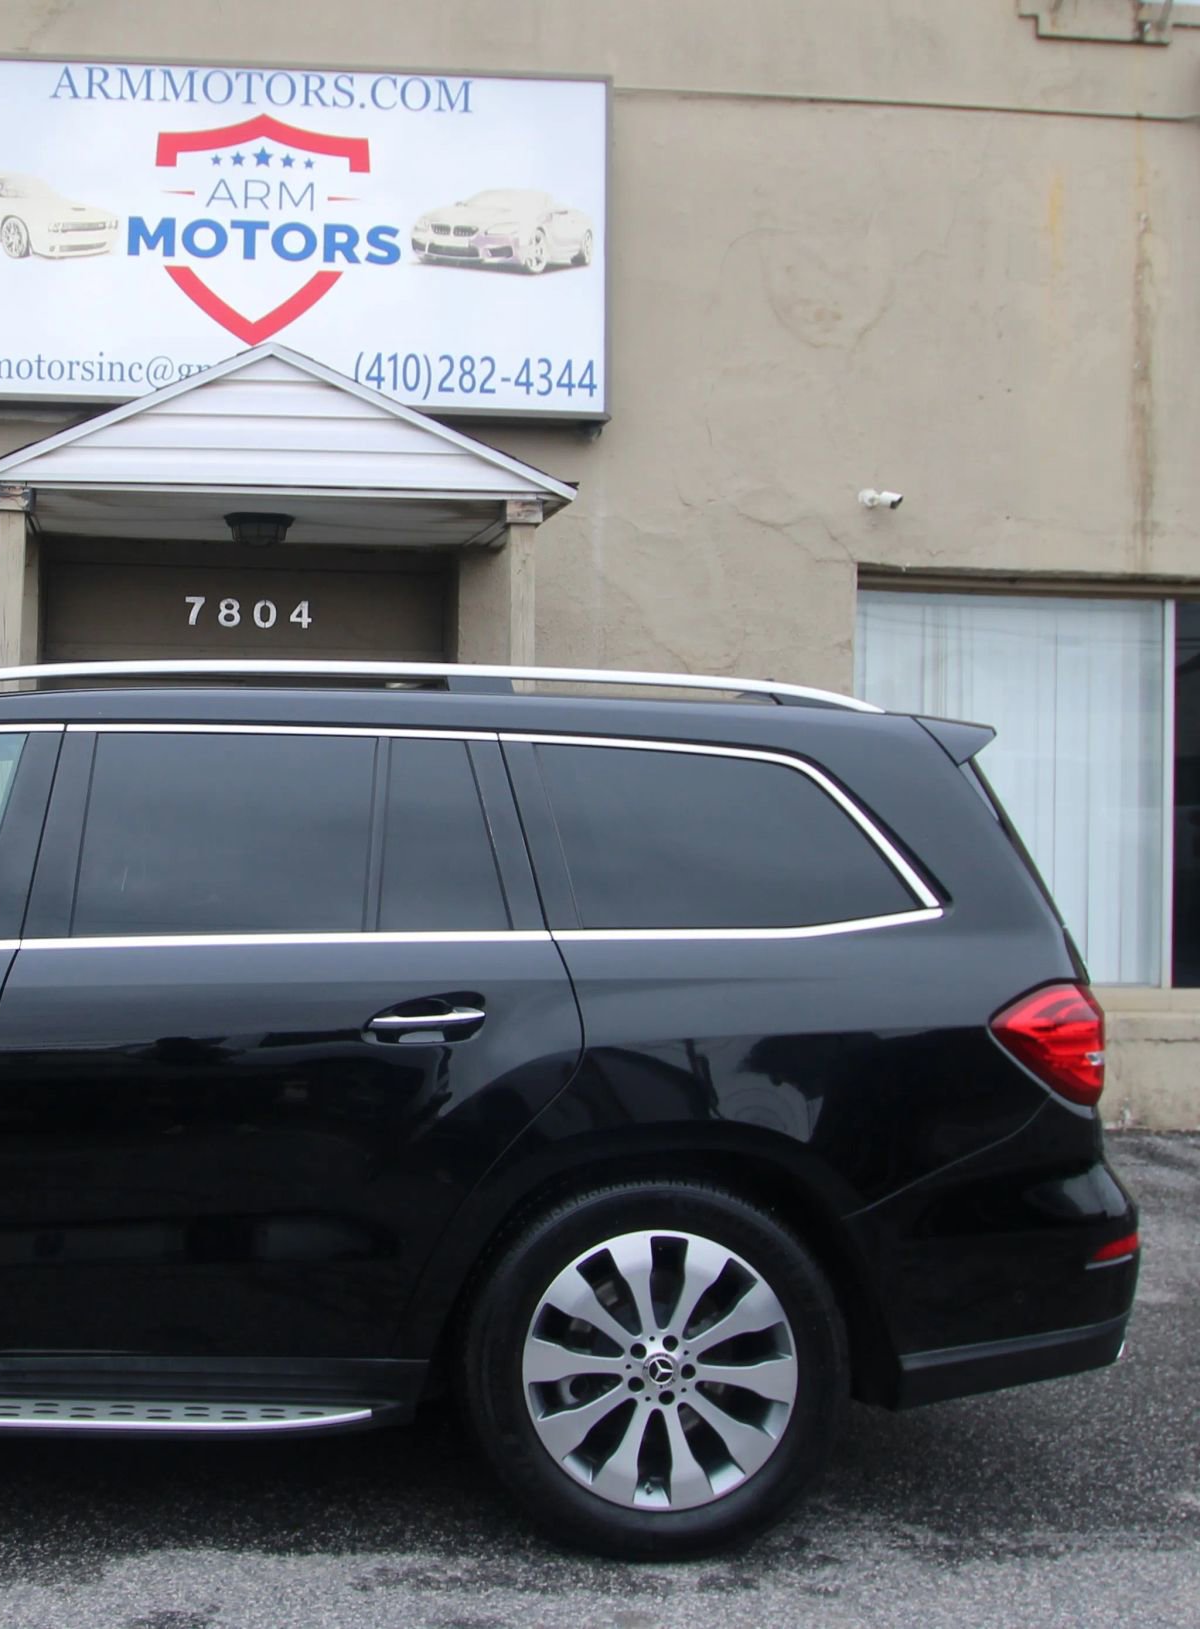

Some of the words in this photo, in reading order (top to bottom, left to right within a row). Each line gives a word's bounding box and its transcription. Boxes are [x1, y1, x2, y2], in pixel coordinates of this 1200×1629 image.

[51, 66, 474, 113] ARMMOTORS.COM
[207, 179, 315, 211] ARM
[127, 216, 402, 266] MOTORS
[354, 351, 598, 400] (410)282-4344
[185, 596, 313, 629] 7804
